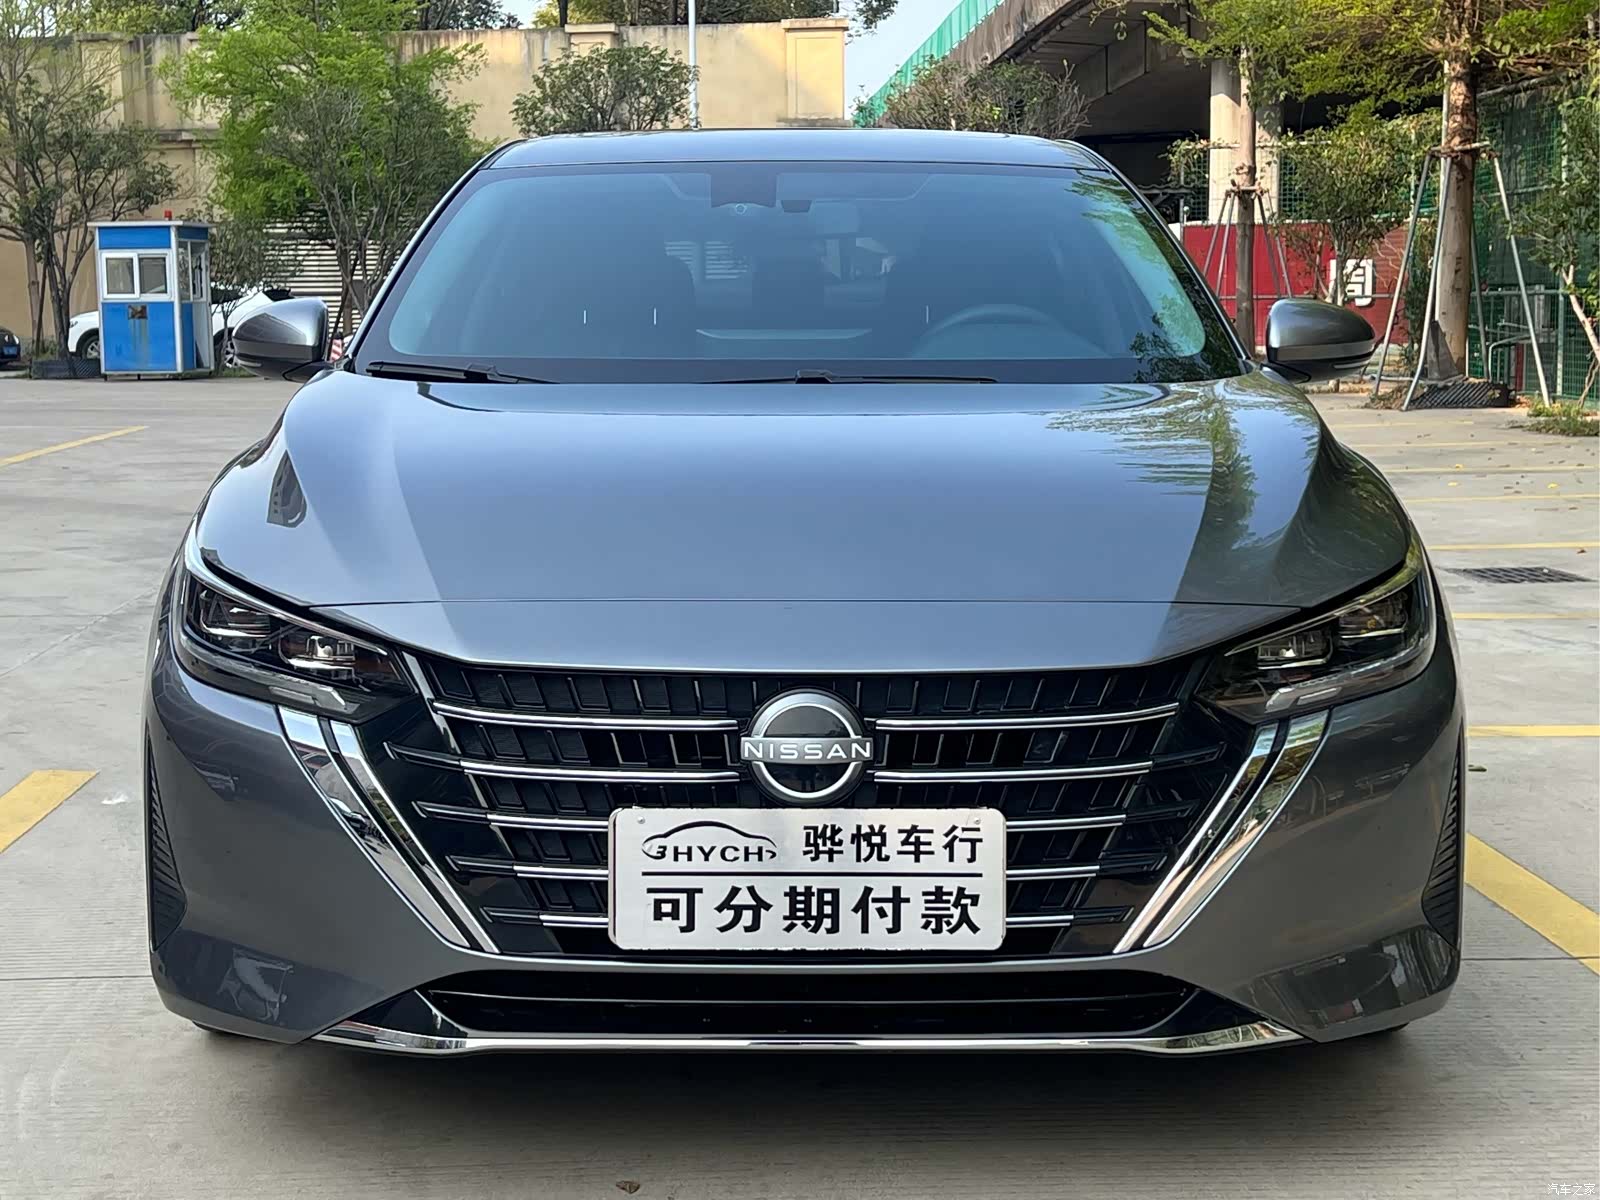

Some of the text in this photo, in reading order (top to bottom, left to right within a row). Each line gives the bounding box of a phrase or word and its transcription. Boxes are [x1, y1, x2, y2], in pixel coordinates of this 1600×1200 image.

[744, 741, 870, 759] NISSAN
[802, 824, 983, 863] 骅悦车行
[646, 885, 981, 934] 可分期付款
